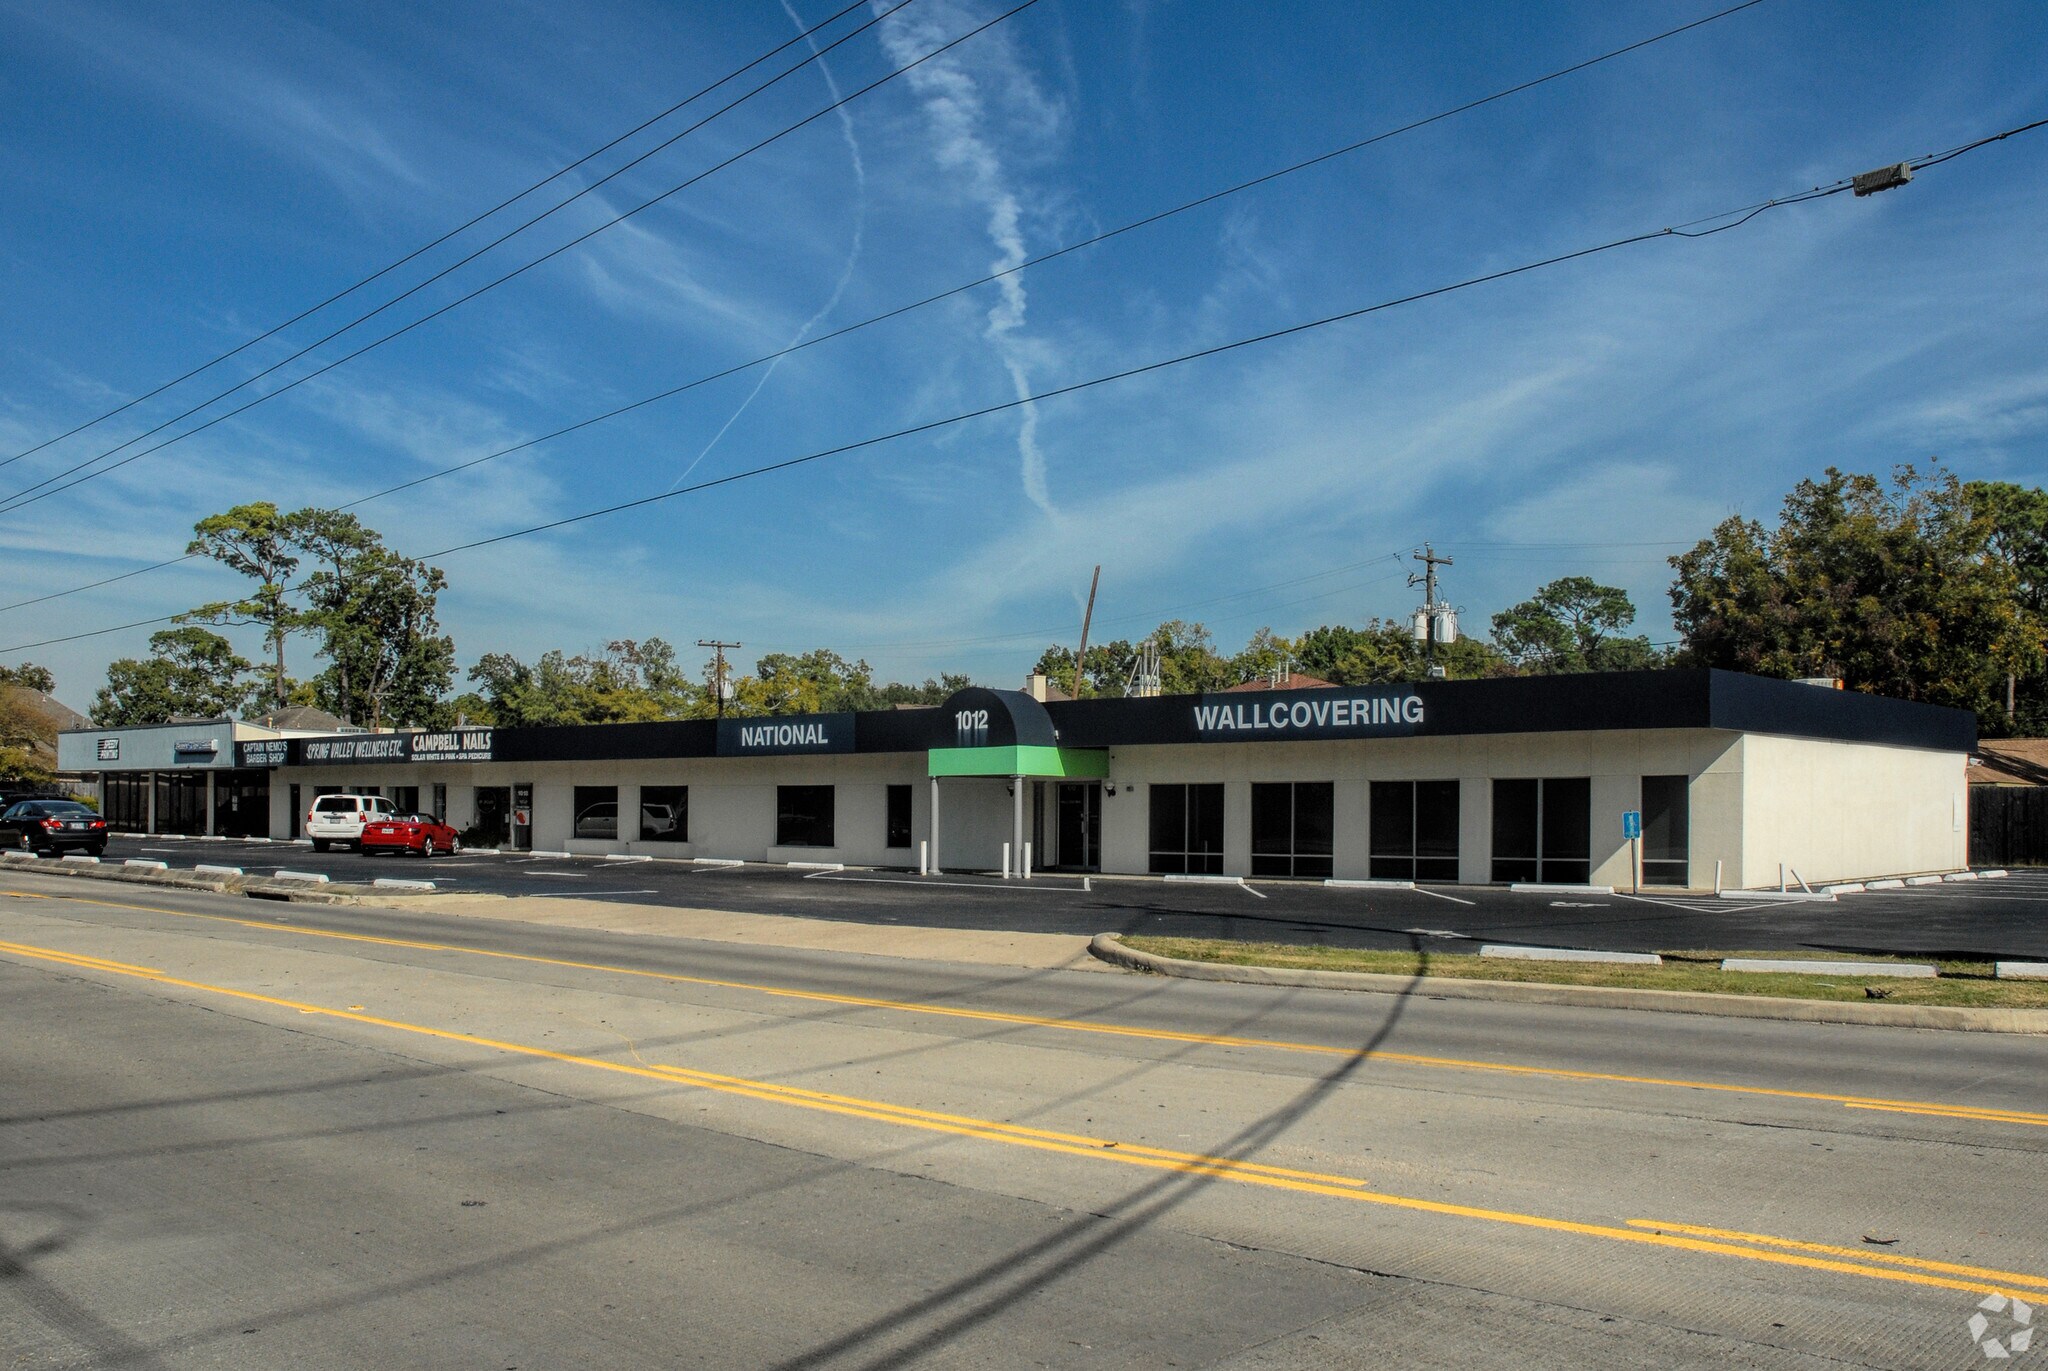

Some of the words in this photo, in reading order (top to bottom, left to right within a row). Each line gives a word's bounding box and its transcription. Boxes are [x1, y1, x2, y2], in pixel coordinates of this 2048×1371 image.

[955, 709, 989, 730] 1012
[1194, 696, 1424, 730] WALLCOVERING
[412, 733, 460, 752] CAMPBELL
[463, 732, 492, 750] NAILS
[741, 723, 828, 746] NATIONAL
[243, 742, 265, 752] CAPTAIN
[265, 741, 288, 752] NEMO'S
[306, 743, 330, 759] SPRING
[330, 742, 356, 758] VALLEY
[355, 740, 389, 758] WELLNESS
[246, 753, 267, 764] BARBER
[268, 752, 285, 763] SHOP
[411, 753, 426, 761] SOLAR
[426, 753, 440, 761] WHITE
[468, 752, 492, 760] PEDICURE
